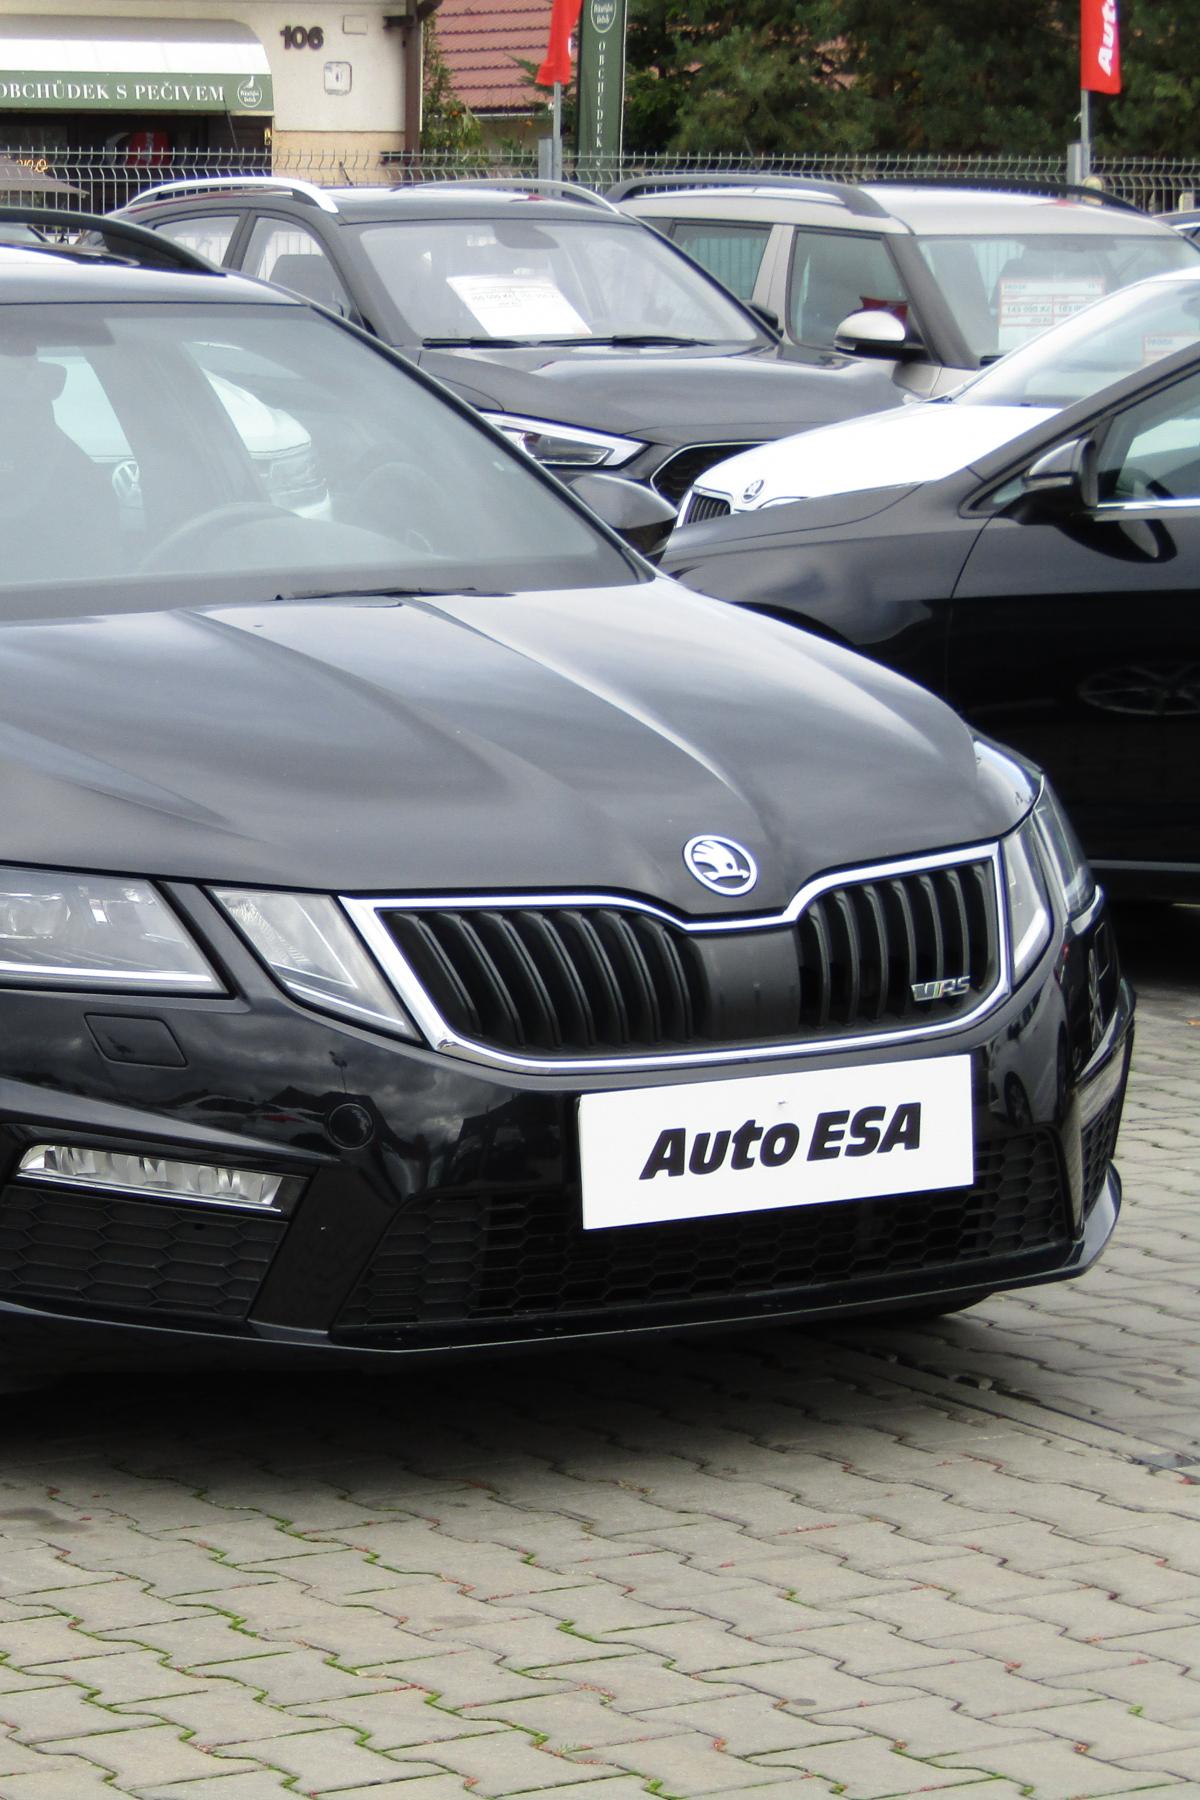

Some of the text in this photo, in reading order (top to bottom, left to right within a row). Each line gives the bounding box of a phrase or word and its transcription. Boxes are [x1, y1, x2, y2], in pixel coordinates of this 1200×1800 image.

[279, 25, 324, 51] 106
[1098, 0, 1117, 77] Aut
[116, 84, 128, 100] S
[134, 81, 225, 102] PEČIVEM
[638, 1101, 922, 1181] Auto ESA
